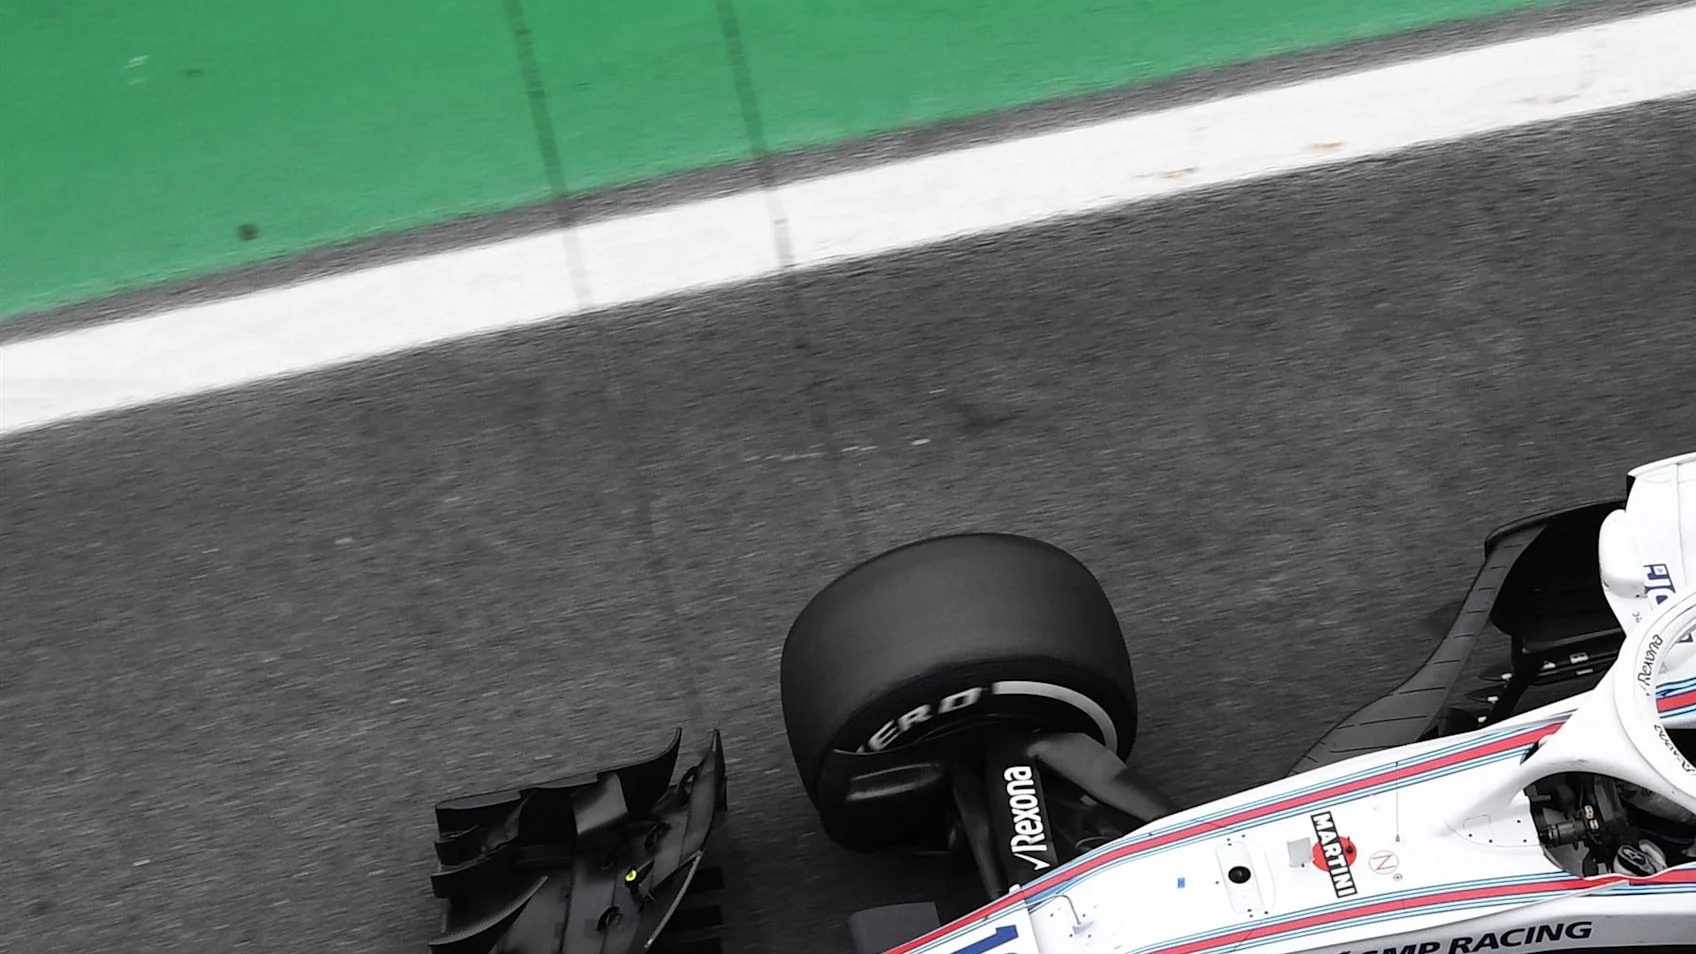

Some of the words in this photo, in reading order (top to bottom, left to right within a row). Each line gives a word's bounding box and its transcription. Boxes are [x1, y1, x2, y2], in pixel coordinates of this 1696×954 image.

[856, 687, 981, 753] ERO
[1004, 766, 1048, 853] Rexona
[1312, 812, 1357, 897] MARTINI
